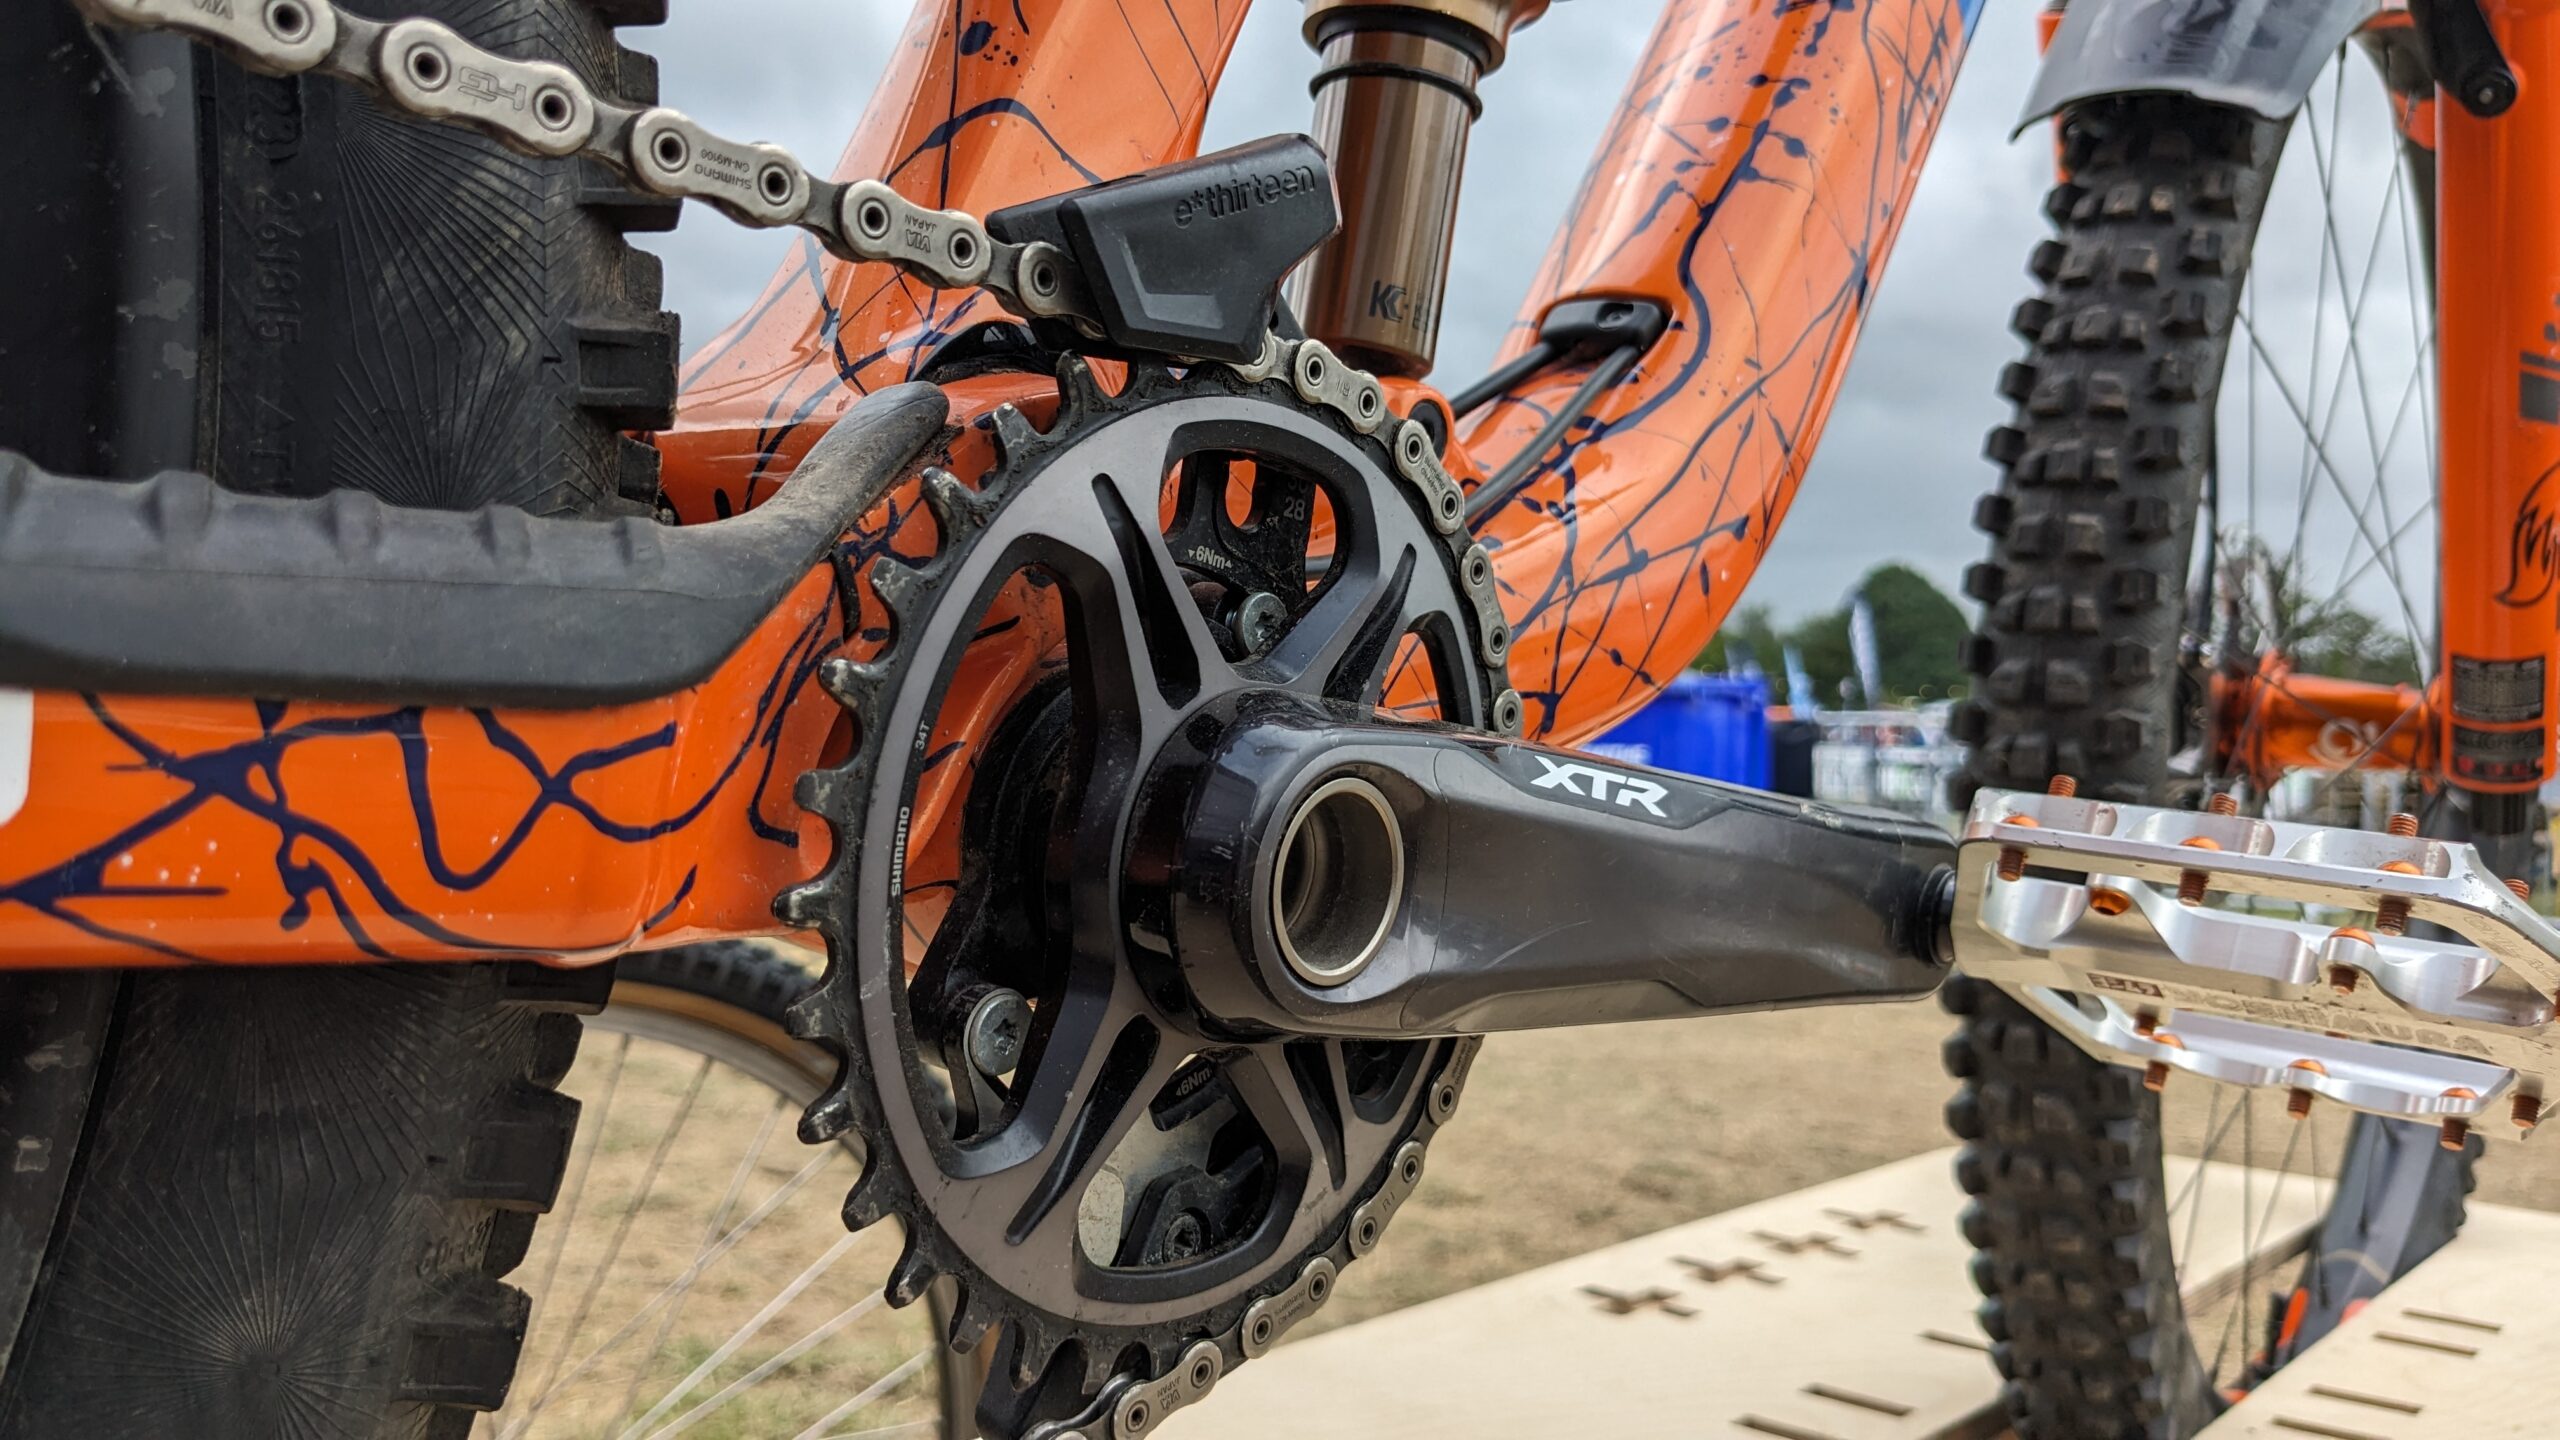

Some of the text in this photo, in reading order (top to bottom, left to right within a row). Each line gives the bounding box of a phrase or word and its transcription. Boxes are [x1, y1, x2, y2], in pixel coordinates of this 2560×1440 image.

[694, 163, 753, 190] SHIMANO
[905, 214, 937, 232] JAPAN
[905, 229, 931, 253] VIA
[1283, 496, 1305, 521] 28
[1196, 544, 1225, 570] 6Nm
[914, 721, 931, 751] 34T
[1530, 755, 1668, 818] XTR
[890, 806, 910, 897] SHIMANO
[1180, 1068, 1212, 1098] 6Nm
